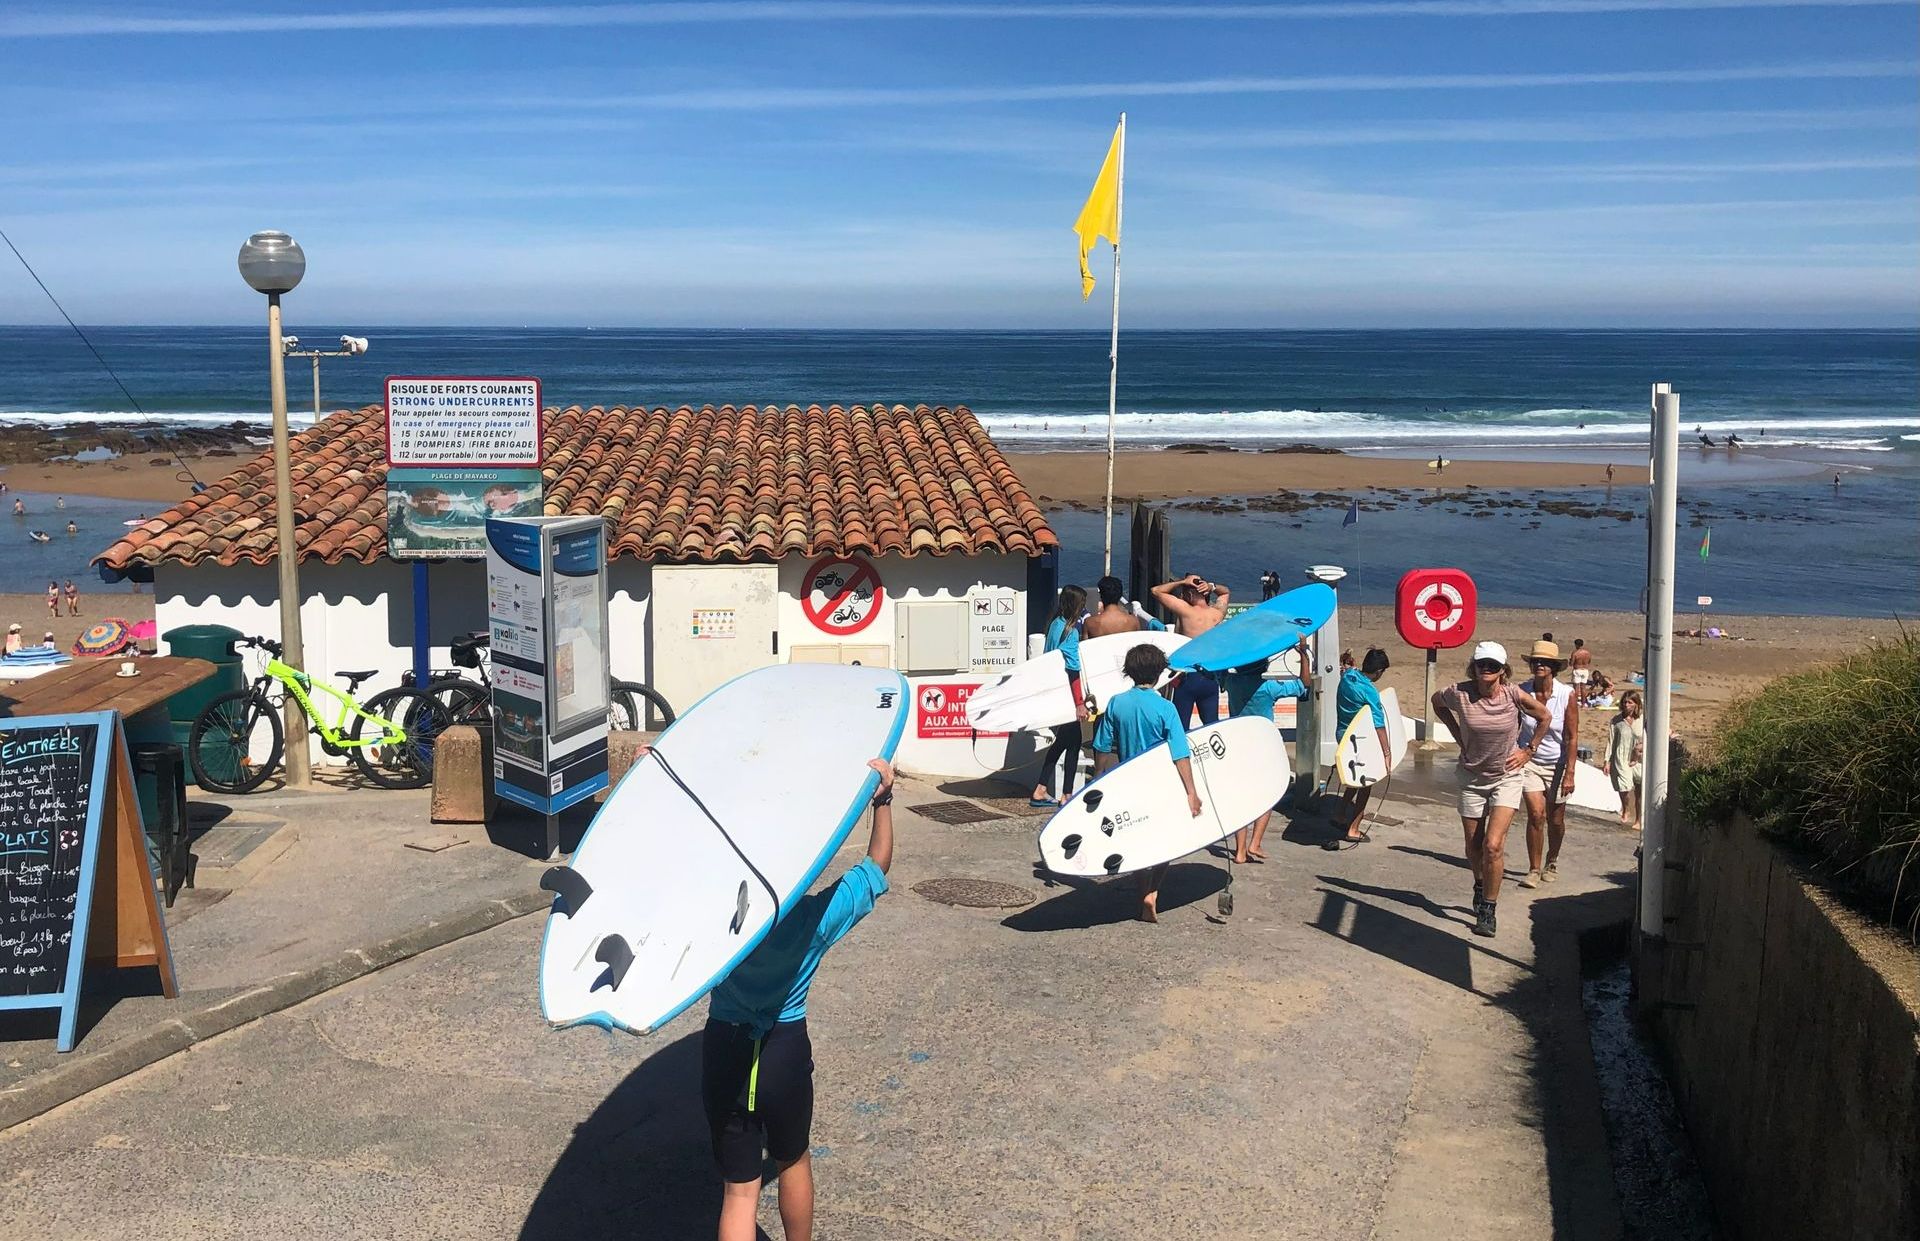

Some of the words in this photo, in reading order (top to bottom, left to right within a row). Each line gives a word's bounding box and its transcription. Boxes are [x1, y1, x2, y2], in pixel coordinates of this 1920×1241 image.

[391, 384, 428, 394] RISQUE
[431, 385, 443, 394] DE
[446, 385, 478, 394] FORTS
[480, 385, 534, 394] COURANTS
[392, 397, 435, 406] STRONG
[439, 397, 535, 406] UNDERCURRENTS
[392, 409, 410, 417] Pour
[413, 410, 442, 418] appeler
[437, 421, 482, 429] emergency
[485, 420, 512, 428] please
[416, 430, 449, 438] (SAMU)
[453, 430, 517, 438] (EMERGENCY)
[414, 440, 465, 449] (POMPIERS)
[469, 440, 490, 448] (FIRE
[494, 440, 536, 448] BRIGADE)
[412, 451, 426, 459] (sur
[440, 451, 474, 460] portable)
[476, 451, 487, 459] (on
[508, 451, 536, 459] mobile)
[982, 625, 1005, 633] PLAGE
[972, 657, 1015, 666] SURVEILLÉE
[924, 716, 949, 726] AUX
[2, 733, 79, 759] ENTRÉES
[23, 765, 36, 773] du
[27, 785, 53, 796] Toast
[29, 798, 38, 810] la
[23, 813, 33, 824] la
[9, 890, 39, 907] basque
[20, 909, 28, 921] la
[13, 963, 26, 975] du
